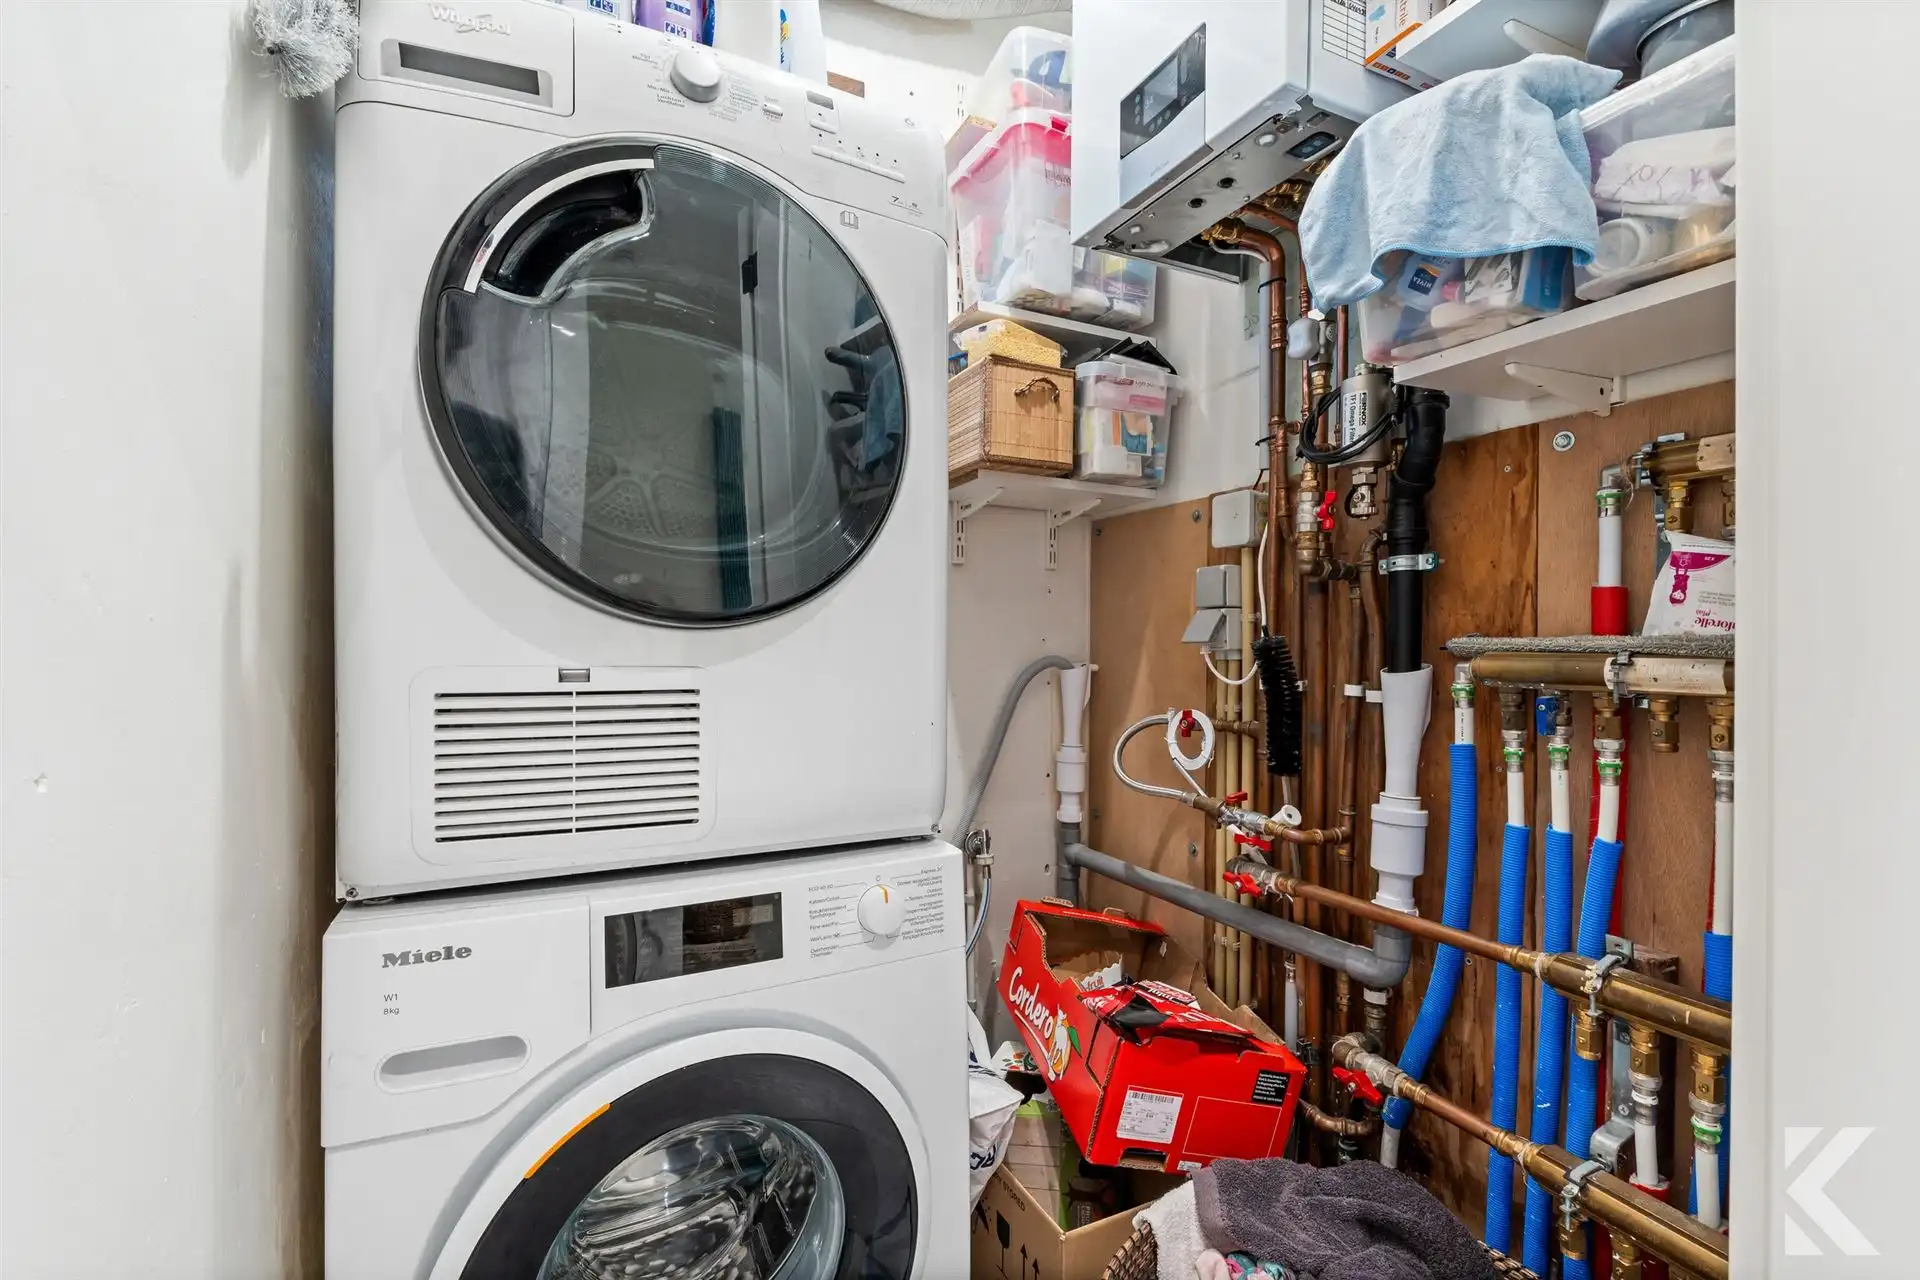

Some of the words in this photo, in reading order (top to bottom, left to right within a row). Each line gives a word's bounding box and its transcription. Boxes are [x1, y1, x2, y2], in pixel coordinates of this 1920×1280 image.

[430, 4, 511, 35] Whirlpool
[1412, 275, 1433, 289] NIVEA
[1349, 406, 1357, 426] Omega
[382, 944, 473, 969] Miele
[383, 993, 399, 1002] W1
[1009, 966, 1054, 1039] Cordero
[1002, 1182, 1026, 1212] STORED
